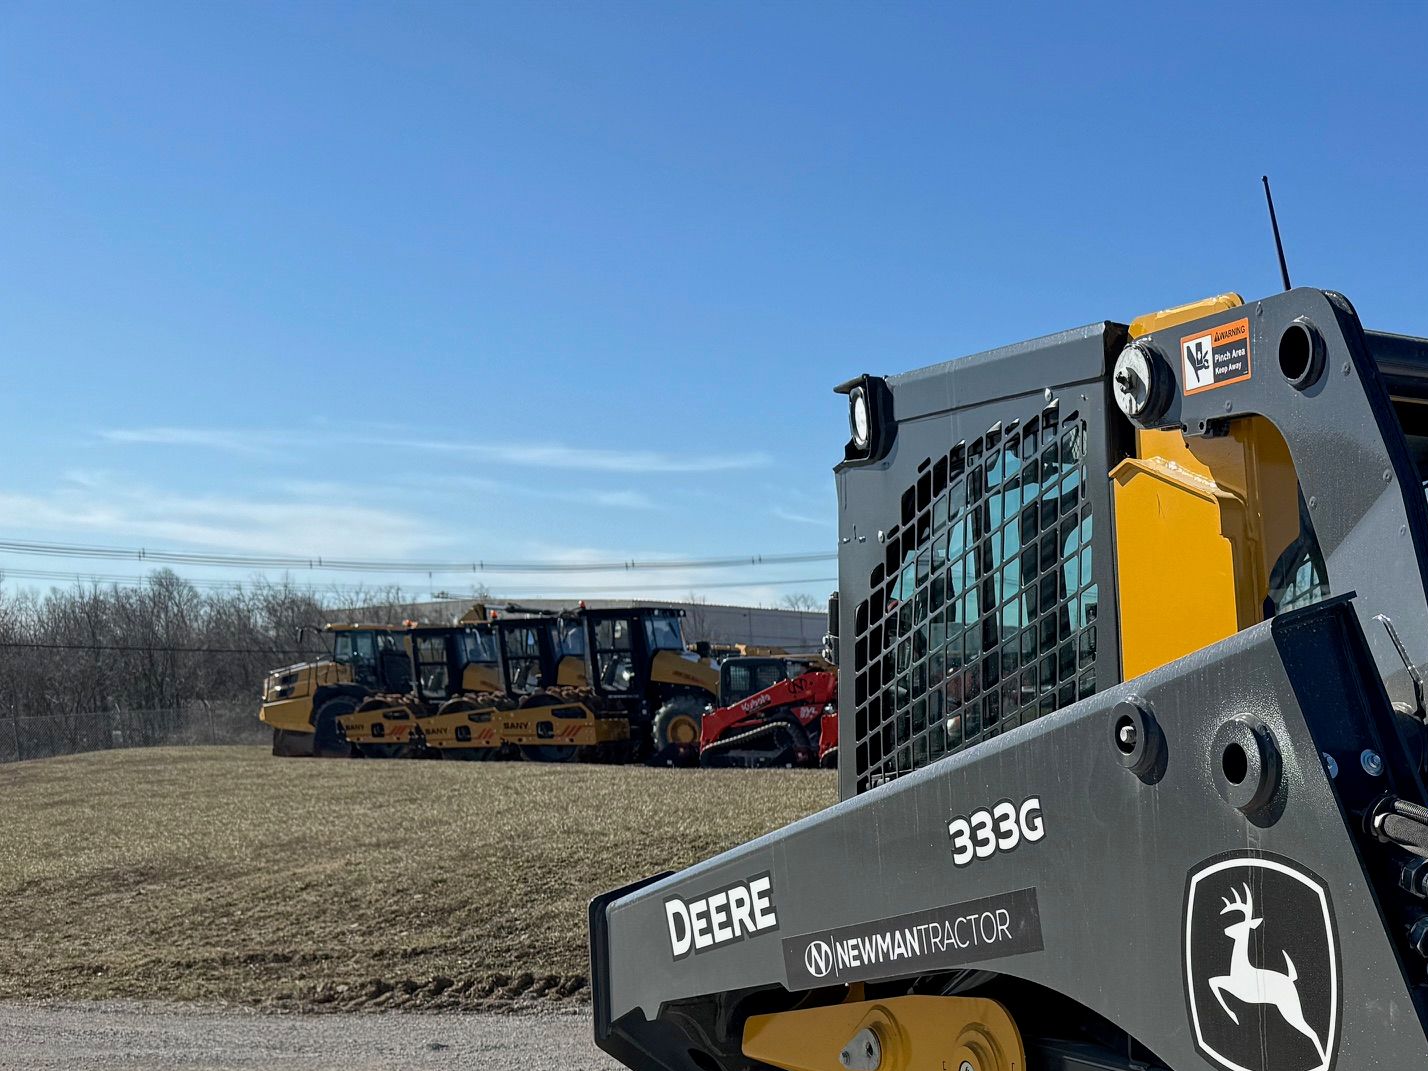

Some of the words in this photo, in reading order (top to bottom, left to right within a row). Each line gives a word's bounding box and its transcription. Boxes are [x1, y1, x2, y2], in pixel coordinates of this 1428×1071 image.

[1219, 325, 1246, 340] WARNING
[1214, 351, 1231, 363] Pinch
[1231, 348, 1246, 358] Area
[1214, 366, 1228, 375] Keep
[1228, 362, 1242, 371] Away
[503, 722, 529, 730] SANY
[948, 798, 1045, 865] 333G
[664, 876, 777, 956] DEERE
